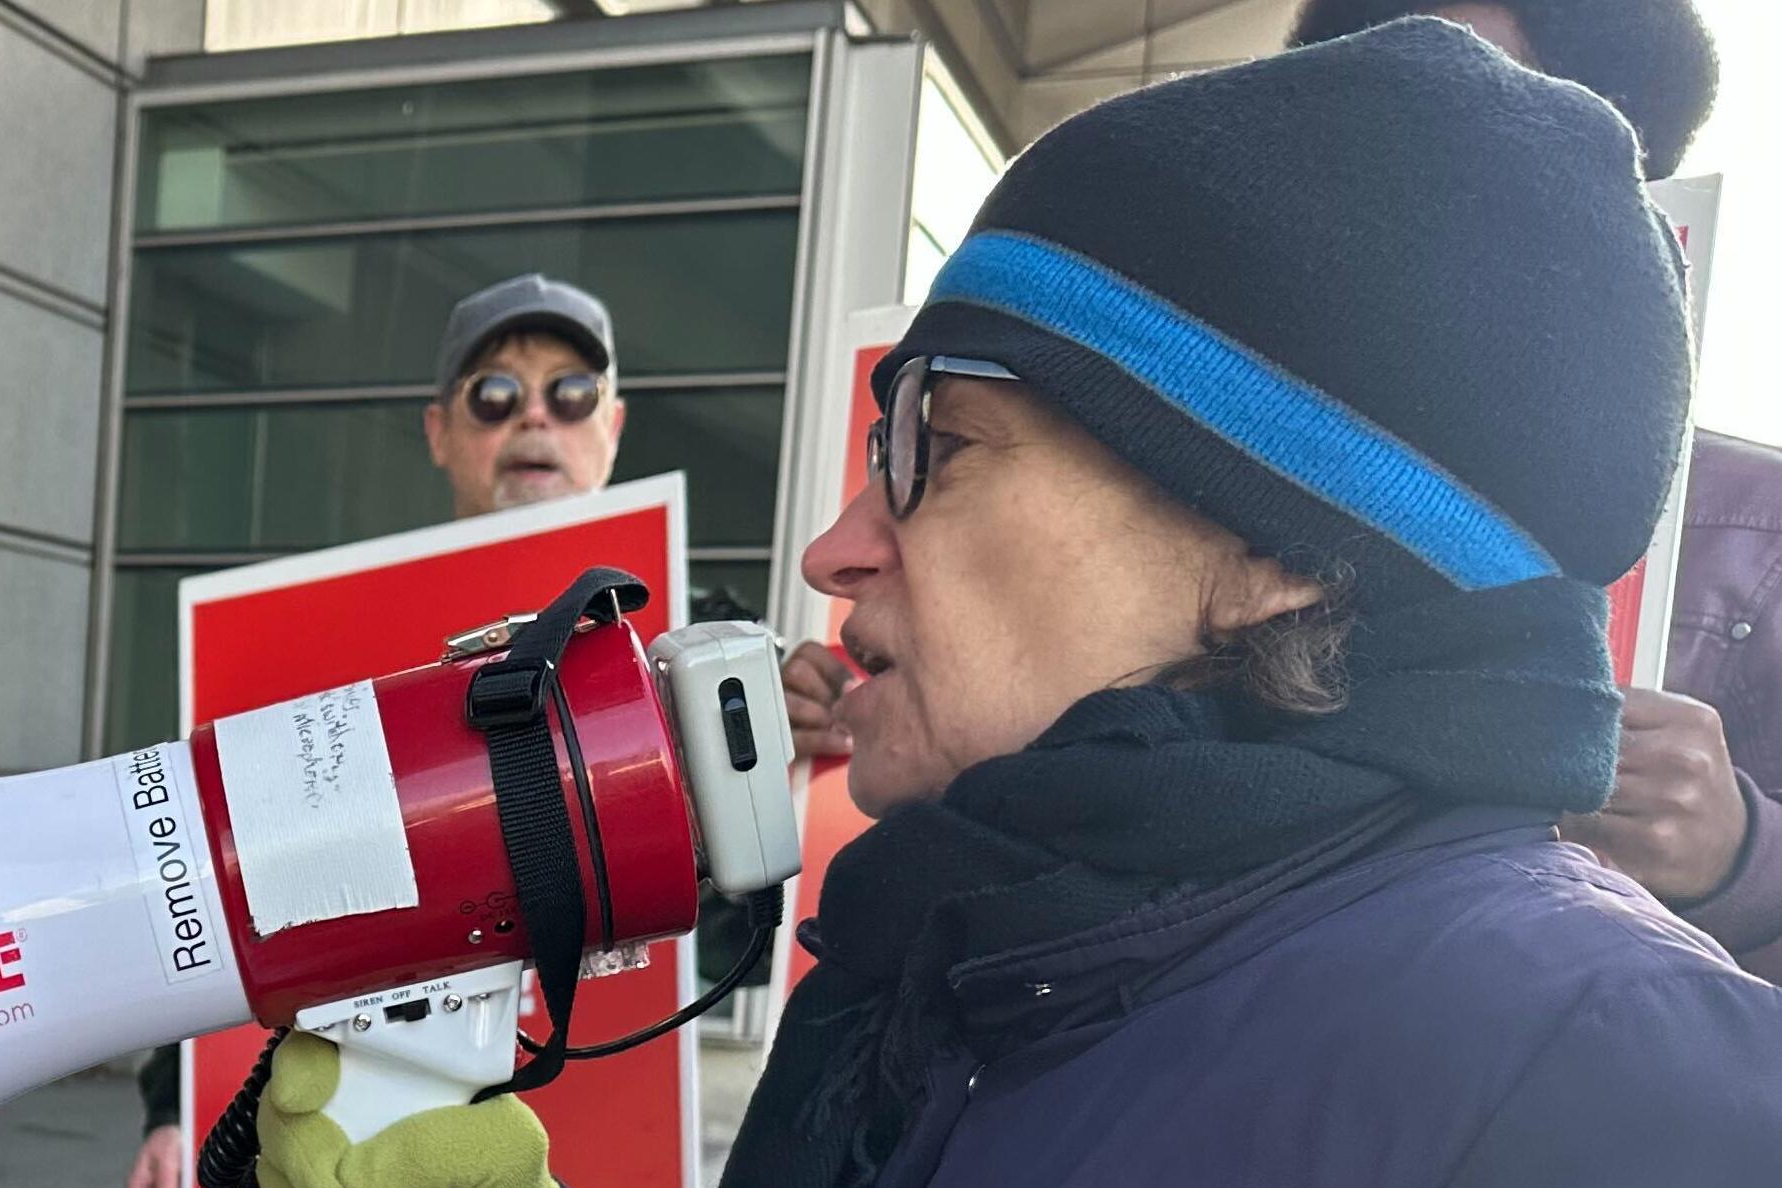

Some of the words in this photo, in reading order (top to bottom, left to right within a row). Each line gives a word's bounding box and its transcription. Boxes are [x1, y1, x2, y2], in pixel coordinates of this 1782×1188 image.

[149, 814, 212, 972] Remove
[353, 995, 384, 1009] SIREN
[391, 989, 412, 1001] OFF
[422, 980, 451, 995] TALK
